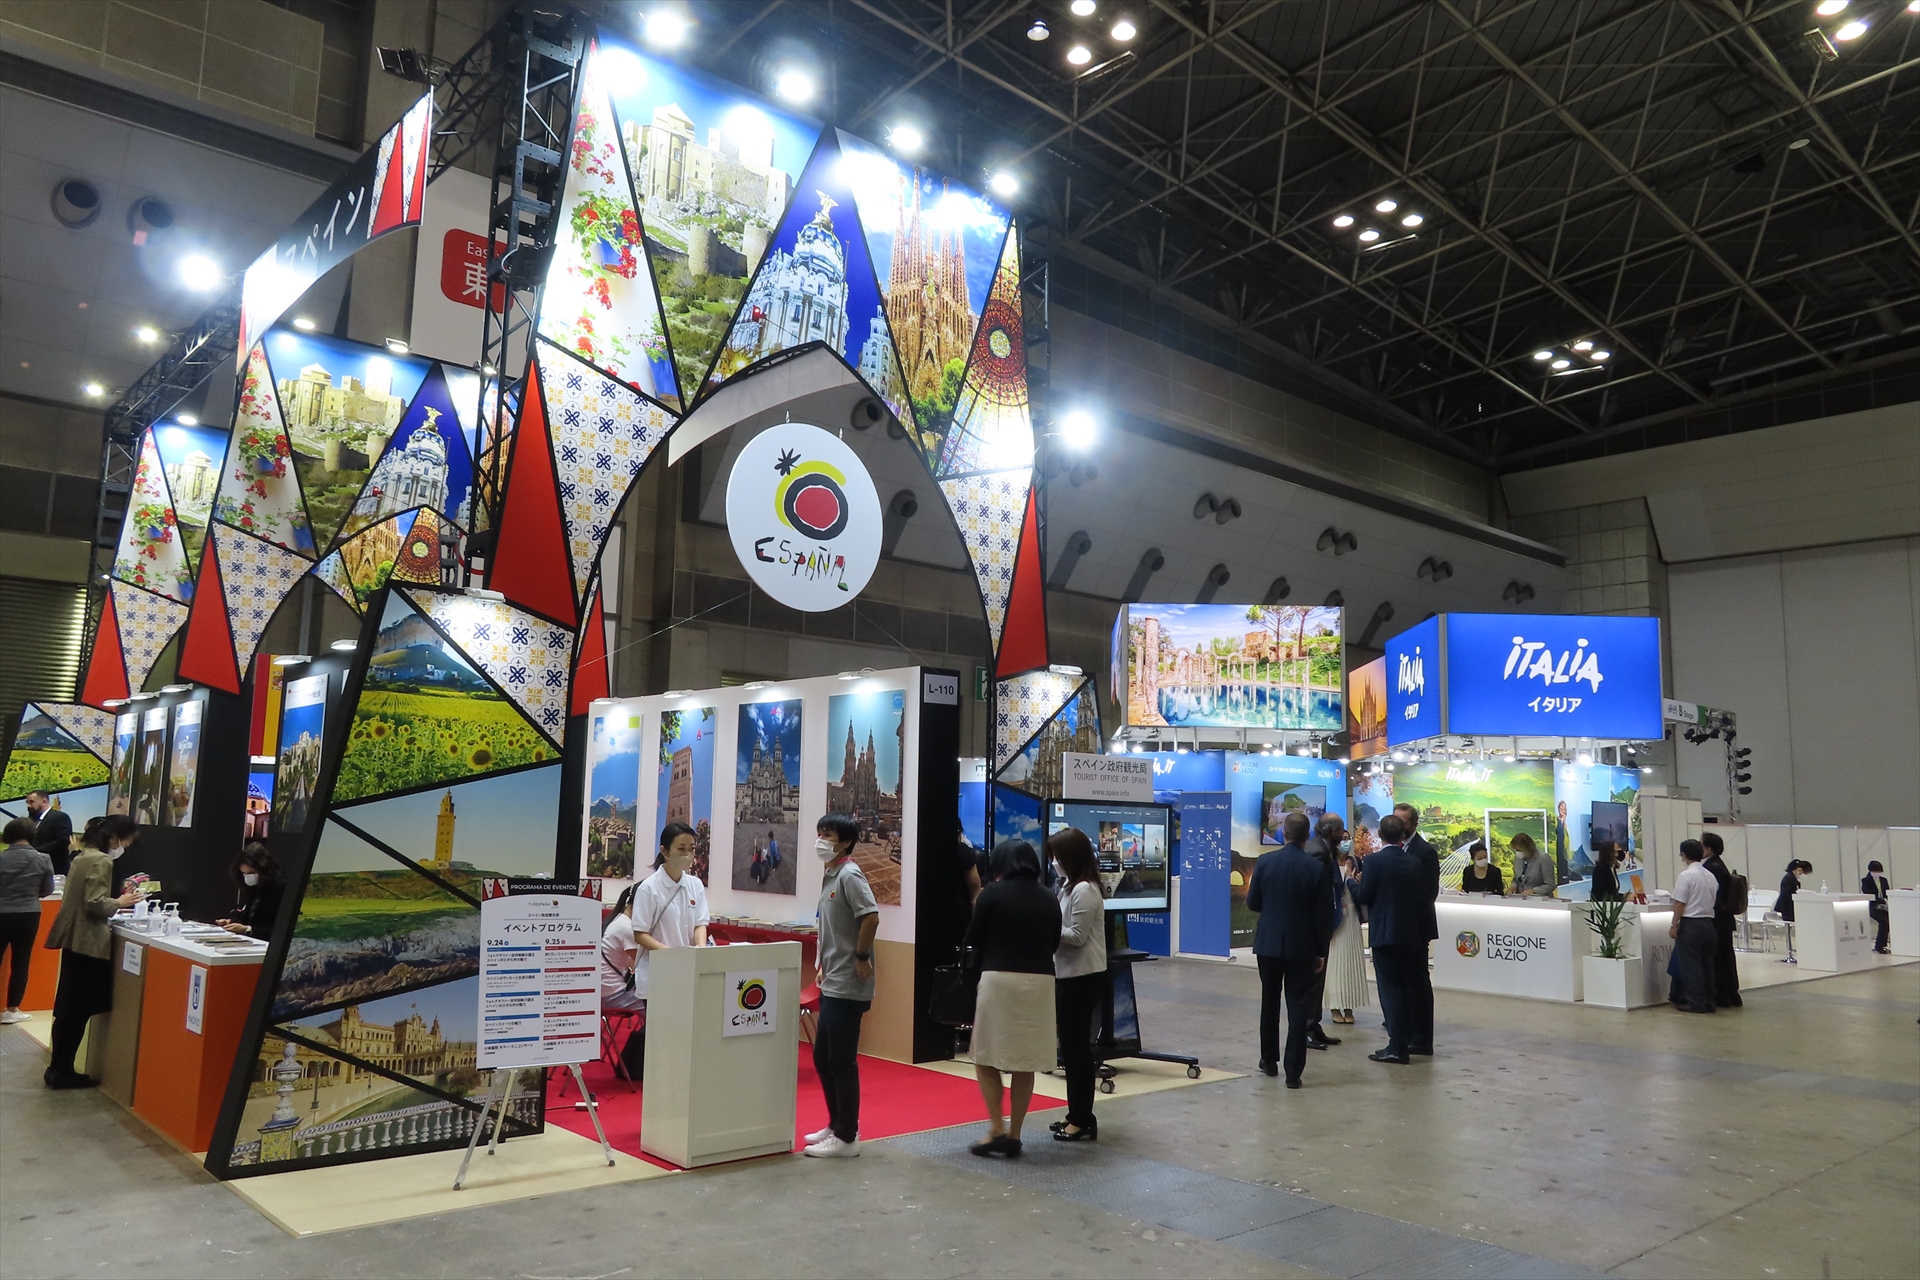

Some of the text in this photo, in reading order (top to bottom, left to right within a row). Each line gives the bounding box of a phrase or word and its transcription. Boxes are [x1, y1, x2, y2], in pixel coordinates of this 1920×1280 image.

[467, 241, 488, 259] Eas
[928, 684, 954, 695] L-110
[1404, 702, 1420, 721] イタリア
[1527, 696, 1582, 713] イタリア
[1074, 758, 1148, 775] スペイン政府観光局
[1074, 772, 1148, 785] TOURIST OFFICE OF SPAIN
[1092, 789, 1130, 797] www.spain.info
[503, 923, 582, 933] イベントプログラム
[1487, 933, 1547, 950] REGIONE
[1487, 947, 1528, 962] LAZIO
